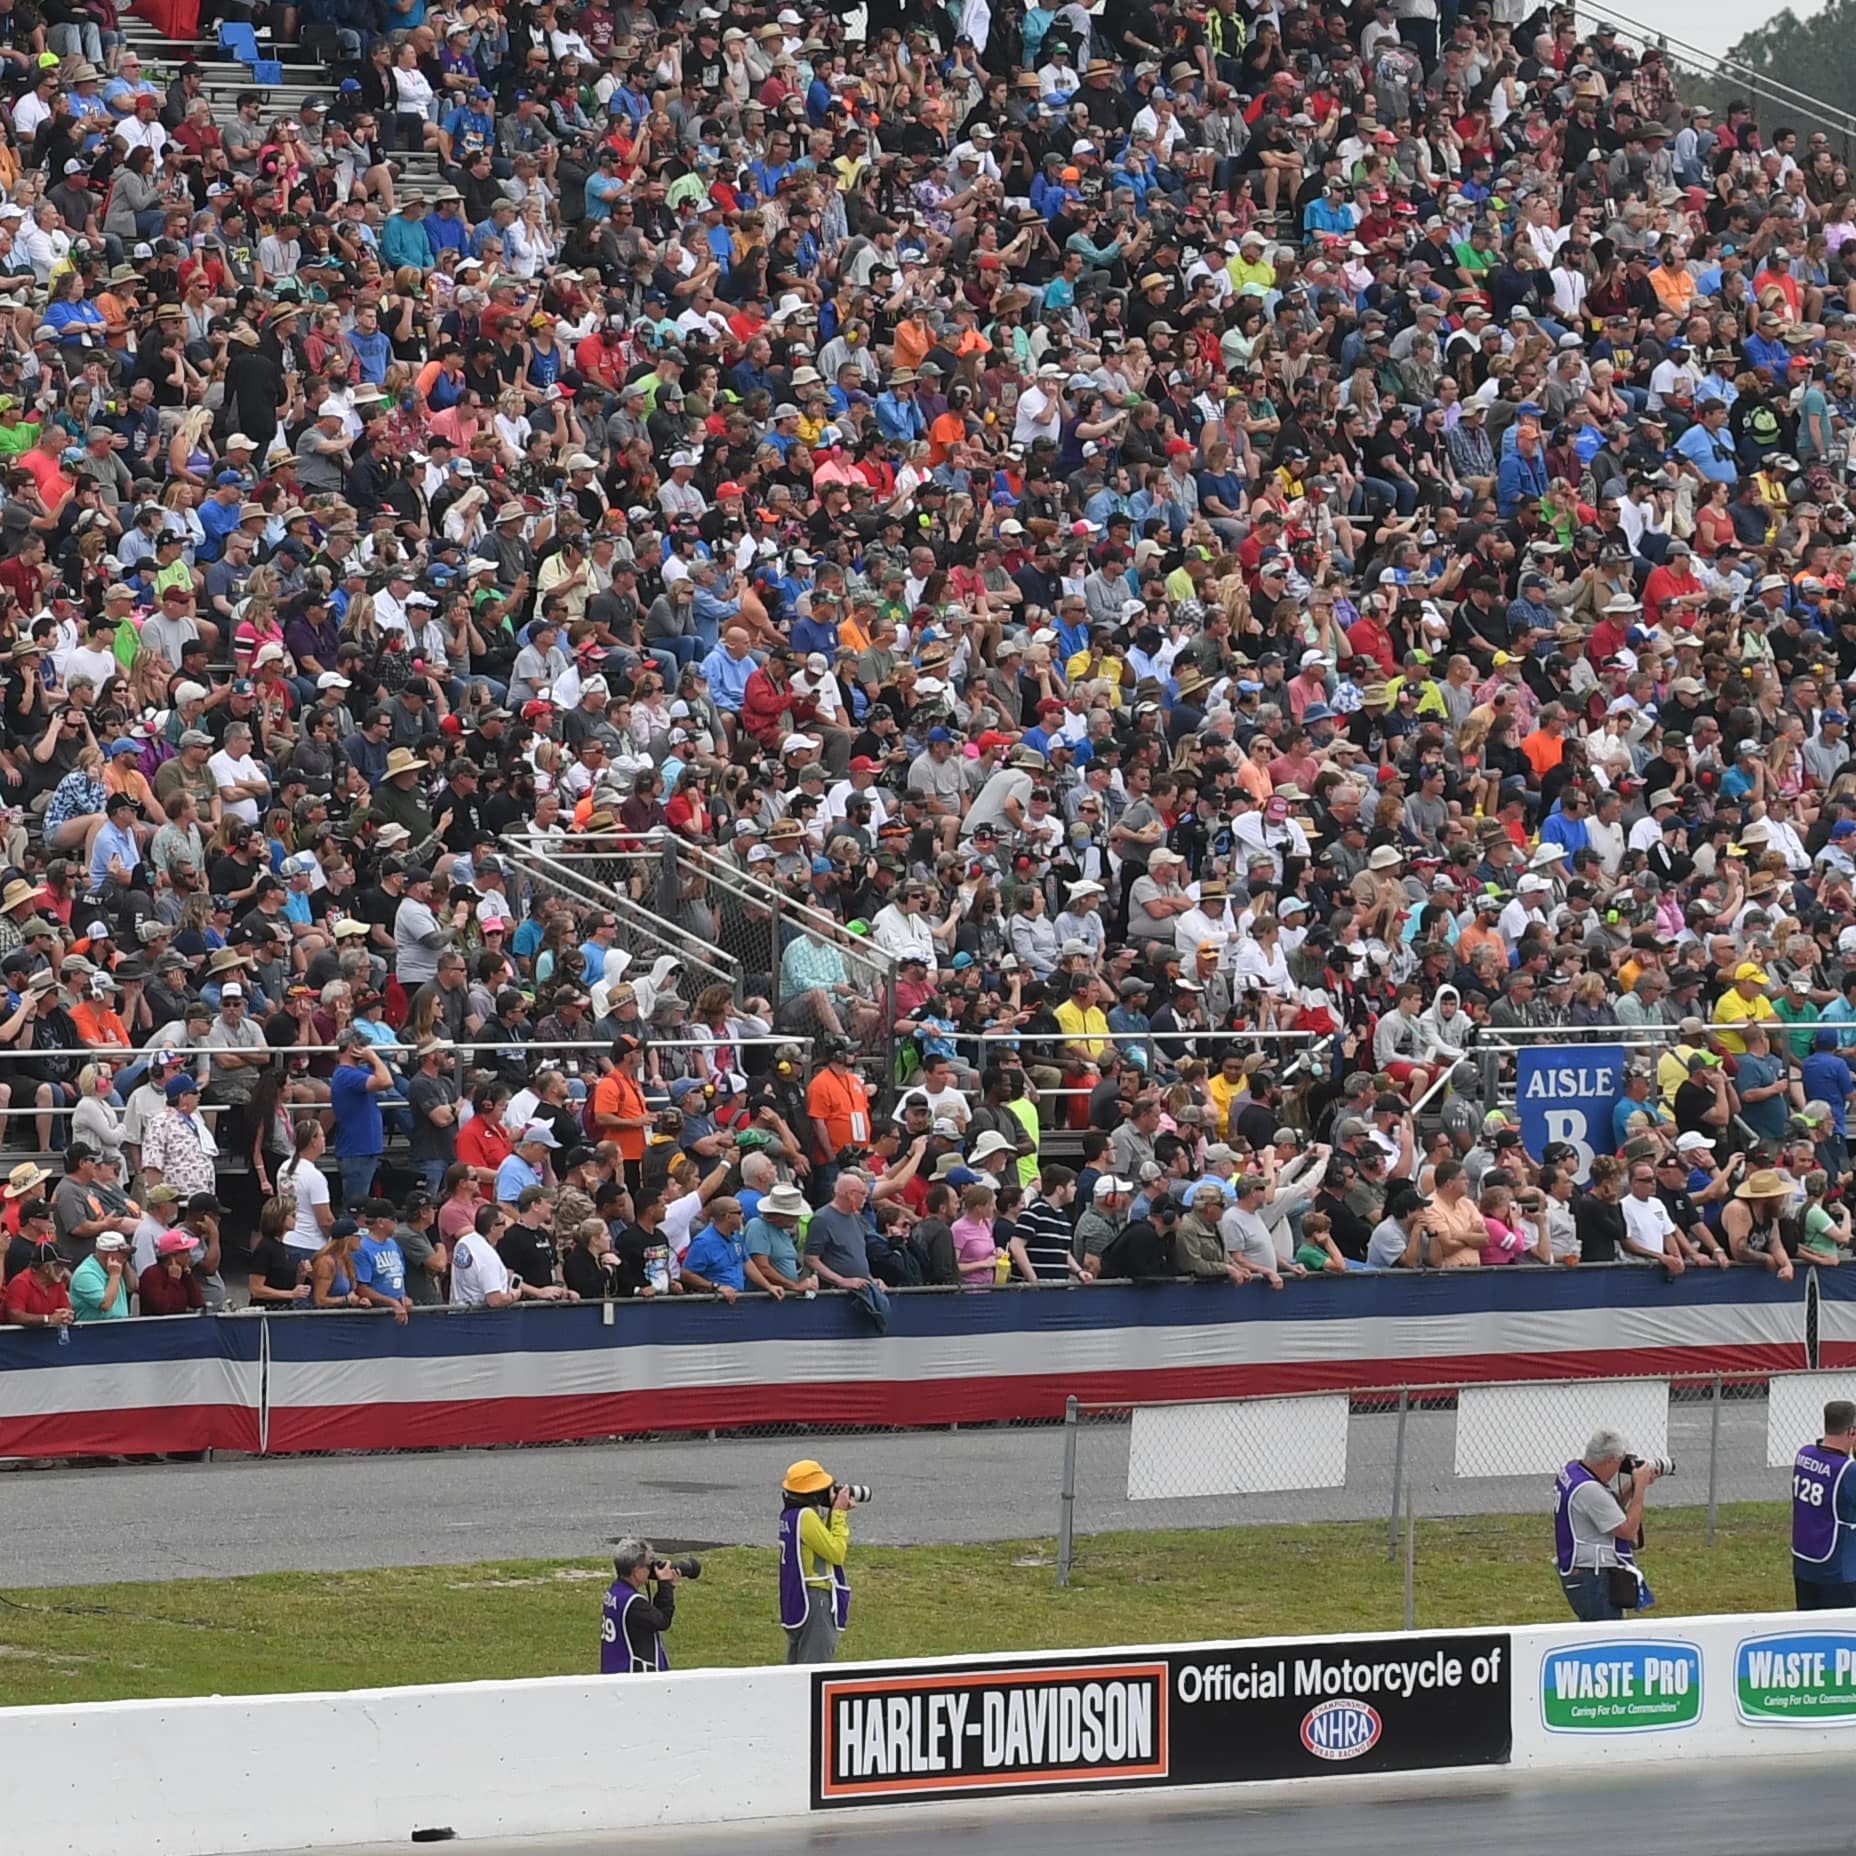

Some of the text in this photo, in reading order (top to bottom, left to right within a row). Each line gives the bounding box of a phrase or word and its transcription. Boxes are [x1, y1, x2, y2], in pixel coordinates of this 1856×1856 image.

[1525, 1066, 1615, 1099] AISLE
[1543, 1108, 1596, 1187] B
[1797, 1454, 1831, 1477] MEDIA
[1793, 1474, 1825, 1506] 128
[1177, 1647, 1501, 1704] Official Motorcycle of
[1554, 1657, 1689, 1700] WASTE PRO
[1747, 1650, 1825, 1689] WASTE
[1314, 1700, 1367, 1716] CHAMPIONSHIP
[1570, 1702, 1677, 1719] Caring For Our Communities
[1763, 1695, 1790, 1709] Caring
[1789, 1694, 1802, 1705] For
[1803, 1693, 1818, 1704] Our
[838, 1681, 1152, 1778] HARLEY-DAVIDSON
[1313, 1710, 1370, 1748] NHRA
